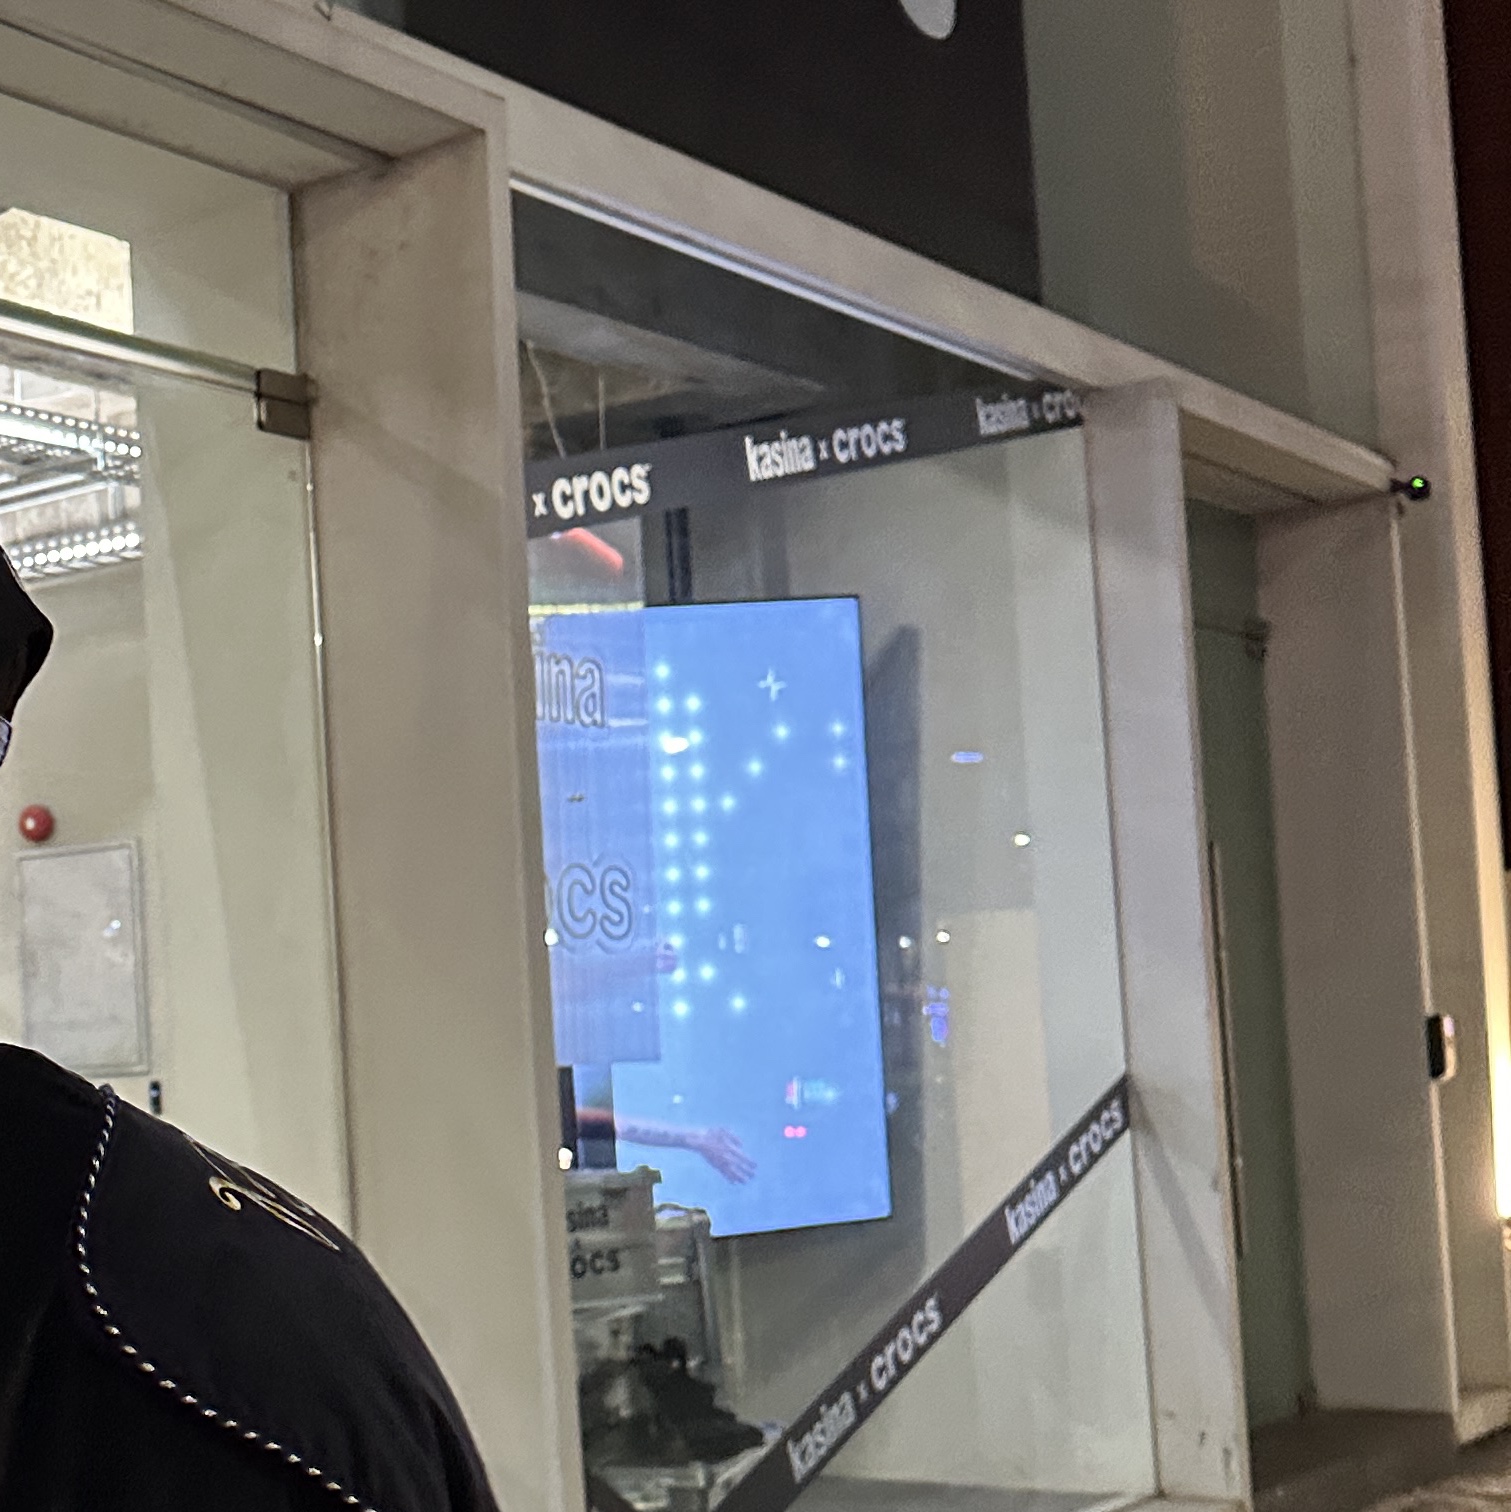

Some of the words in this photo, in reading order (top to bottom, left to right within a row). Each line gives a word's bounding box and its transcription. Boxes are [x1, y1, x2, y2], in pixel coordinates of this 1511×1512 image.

[744, 430, 816, 481] kasina
[831, 418, 907, 463] crocs
[551, 462, 652, 520] crocs
[1068, 1096, 1123, 1174] crocs
[787, 1391, 857, 1484] kasina
[870, 1292, 943, 1391] crocs
